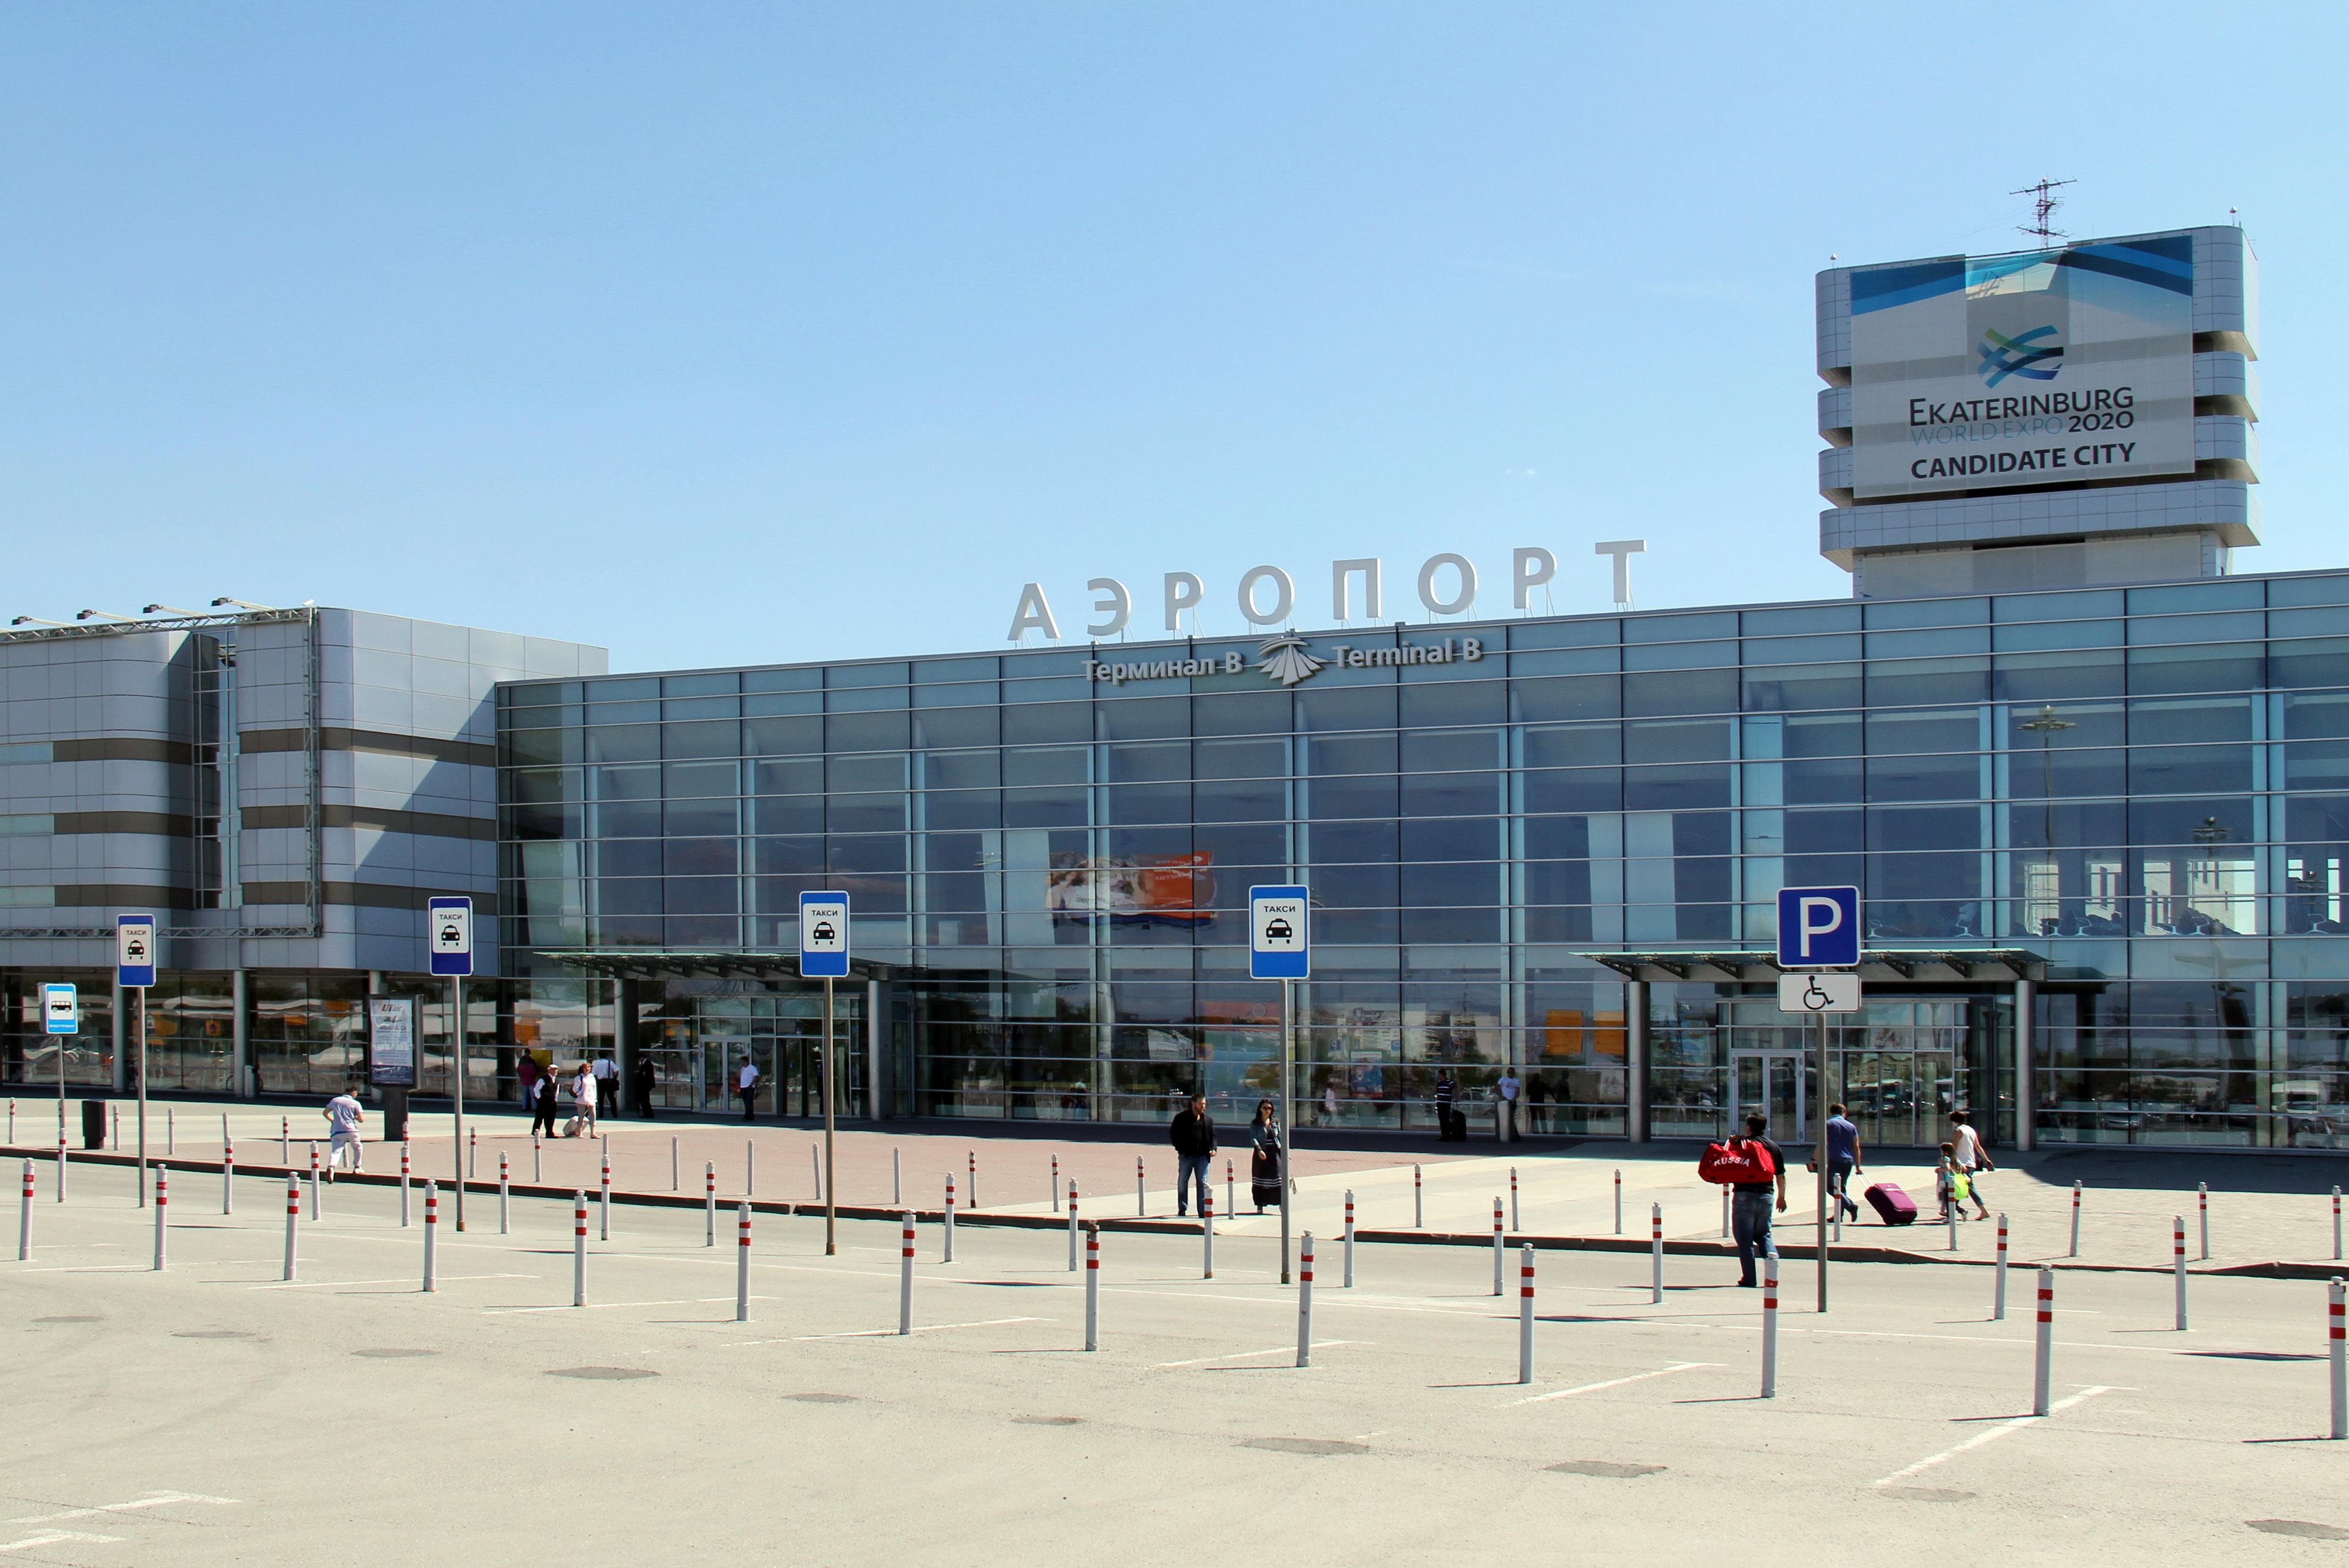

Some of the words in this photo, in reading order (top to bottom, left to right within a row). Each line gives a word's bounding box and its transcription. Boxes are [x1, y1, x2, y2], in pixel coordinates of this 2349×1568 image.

[1910, 386, 2134, 427] EKATERINBURG
[1911, 422, 1997, 446] WORLD
[2004, 416, 2062, 438] EXPO
[2068, 411, 2134, 433] 2020
[1911, 448, 2066, 479] CANDIDATE
[2074, 442, 2136, 465] CITY
[1007, 540, 1647, 640] АЭРОПОРТ
[1332, 638, 1453, 669] Terminal
[1463, 638, 1481, 661] B
[1081, 658, 1216, 686] Терминал
[1800, 897, 1842, 957] P
[1714, 1156, 1750, 1166] RUSSIA
